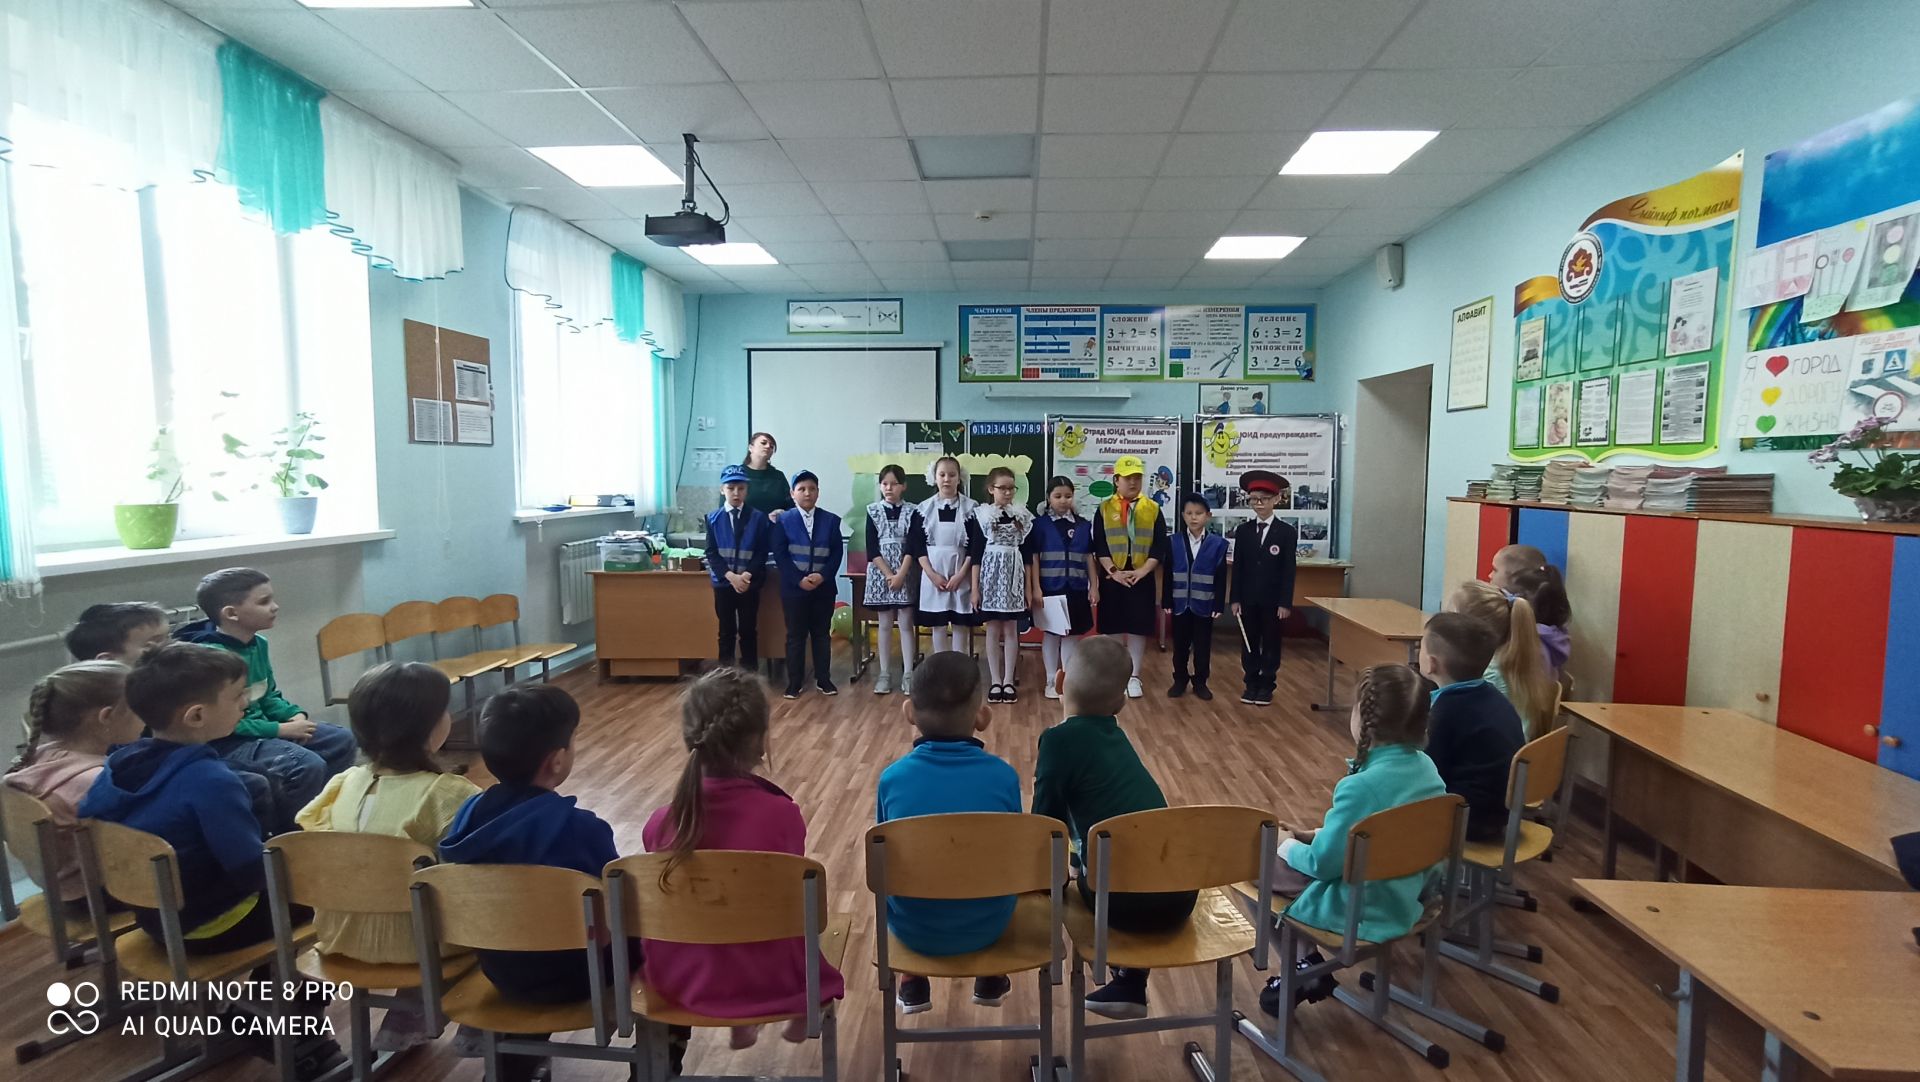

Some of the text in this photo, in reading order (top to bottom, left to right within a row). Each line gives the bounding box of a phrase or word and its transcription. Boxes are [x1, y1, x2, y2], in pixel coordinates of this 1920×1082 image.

[1457, 306, 1487, 323] АЛФАВИТ
[1743, 354, 1842, 382] Я ГОРОД
[1736, 411, 1840, 434] Я ЖИЗНЬ
[1083, 428, 1106, 436] Отряд
[1107, 428, 1126, 436] ЮИД
[1240, 431, 1259, 439] ЮИД
[1149, 447, 1159, 455] РТ
